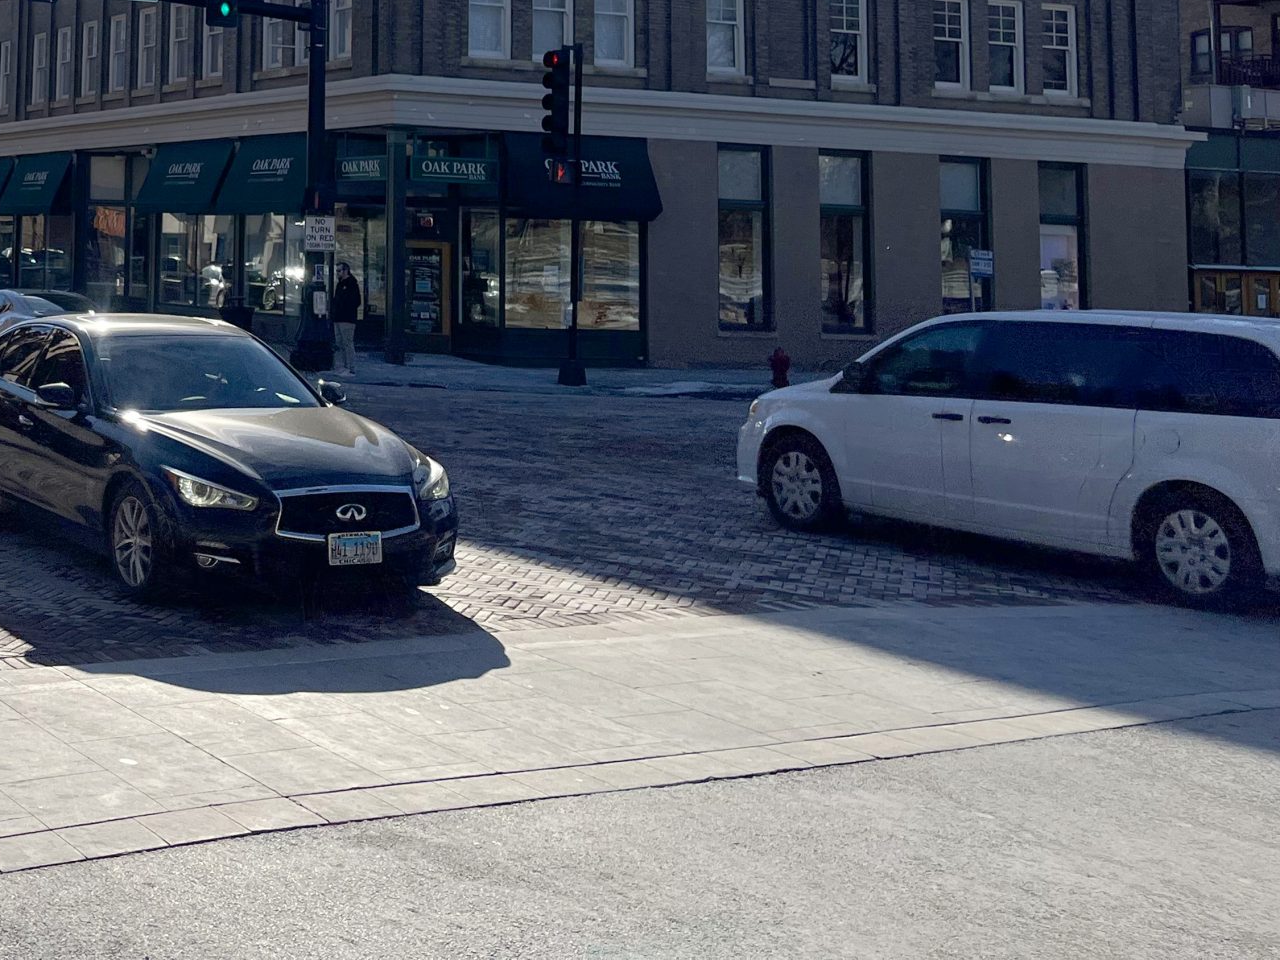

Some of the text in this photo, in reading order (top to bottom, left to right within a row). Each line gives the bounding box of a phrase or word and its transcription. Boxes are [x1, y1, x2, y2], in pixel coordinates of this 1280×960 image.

[168, 162, 204, 174] OAK PARK
[253, 157, 293, 170] OAK PARK
[341, 159, 381, 172] OAK PARK
[422, 160, 486, 175] OAK PARK
[580, 159, 619, 174] PARK
[600, 172, 622, 181] BANK
[315, 218, 326, 226] NO
[310, 226, 331, 234] TURN
[306, 234, 334, 242] ON RED
